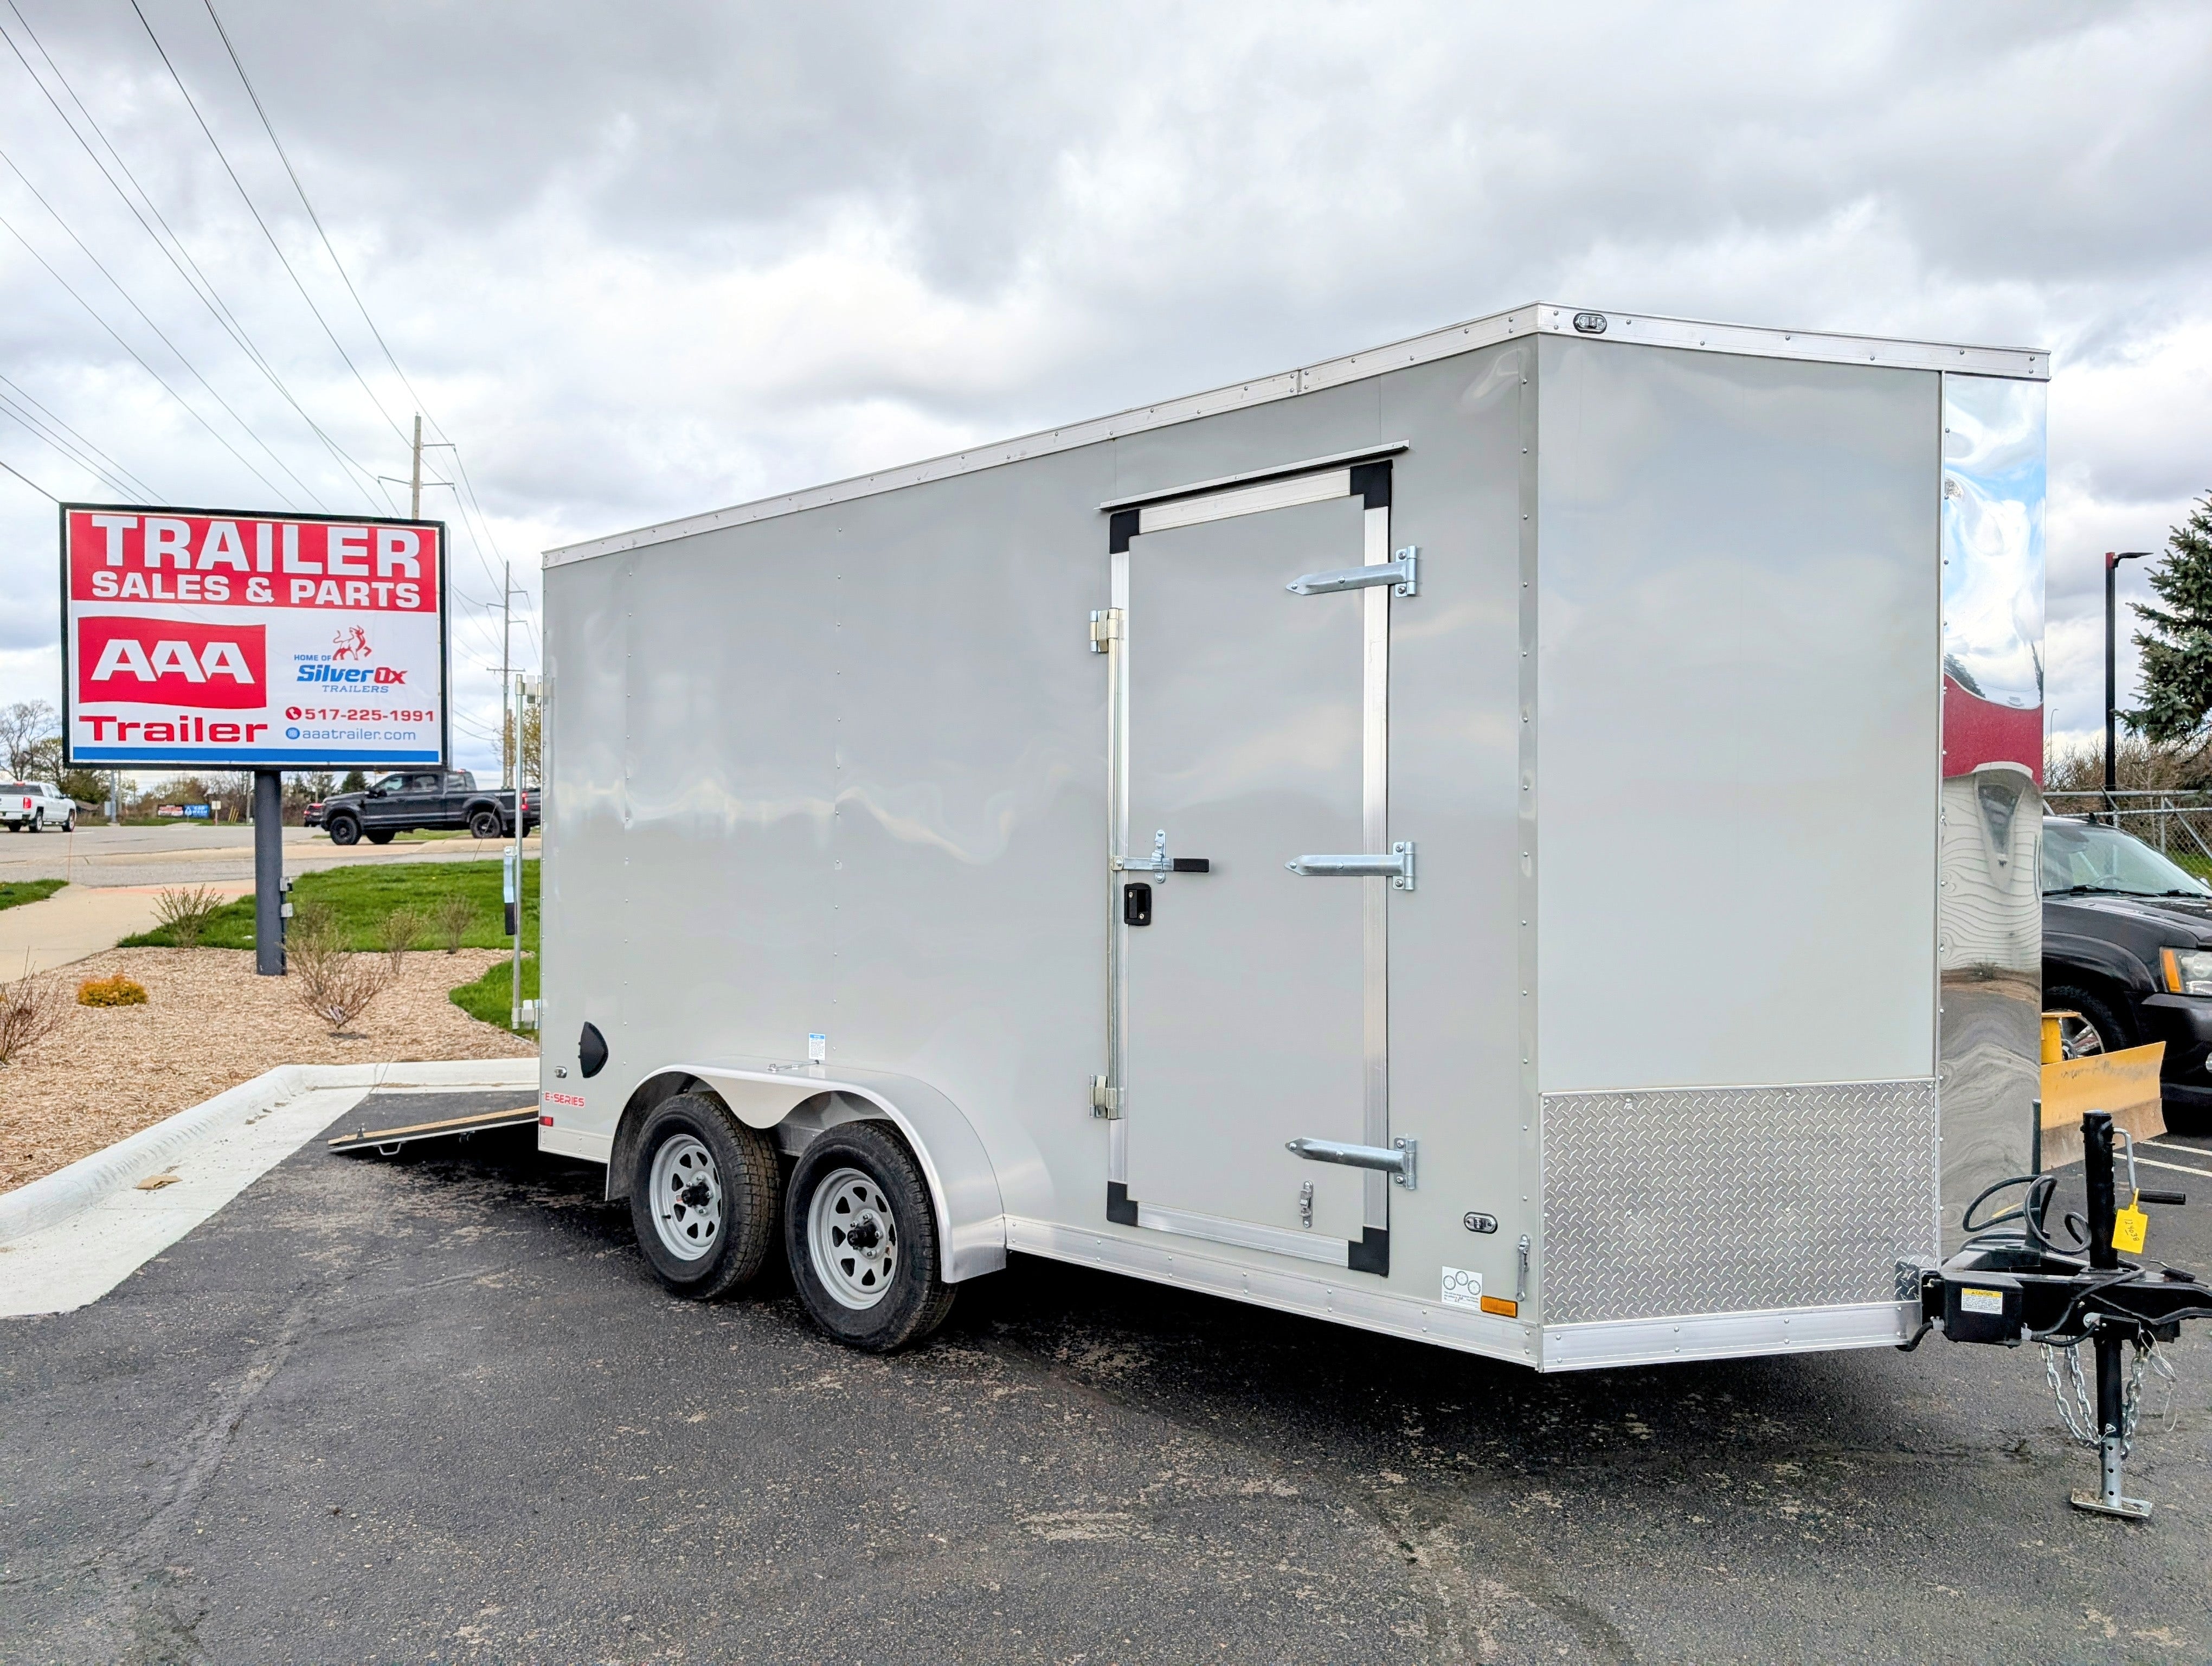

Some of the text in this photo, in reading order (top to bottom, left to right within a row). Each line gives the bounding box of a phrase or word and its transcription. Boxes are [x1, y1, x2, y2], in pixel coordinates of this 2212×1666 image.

[92, 515, 421, 579] TRAILER
[92, 571, 421, 608] SALES & PARTS
[91, 639, 255, 684] AAA
[297, 664, 408, 684] SilverOx
[322, 685, 389, 693] TRAILERS
[305, 708, 433, 722] 517-225-1991
[79, 715, 268, 743] Trailer
[303, 728, 416, 740] aaatrailer.com
[545, 1092, 585, 1107] E-SERIES
